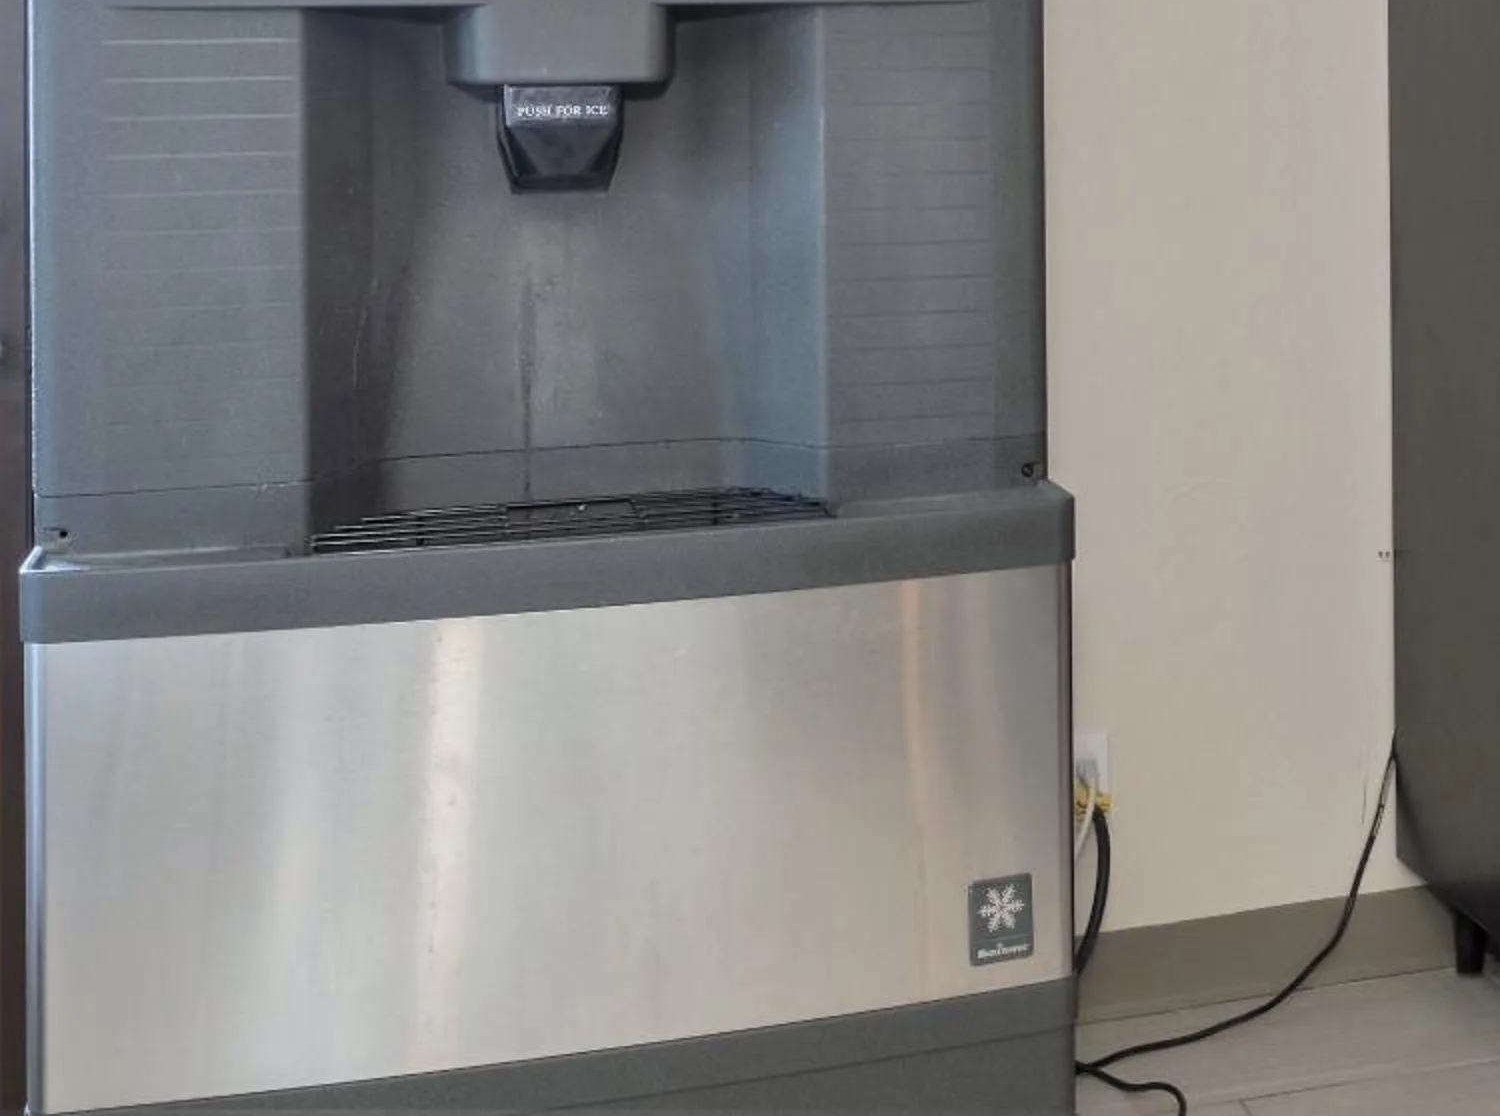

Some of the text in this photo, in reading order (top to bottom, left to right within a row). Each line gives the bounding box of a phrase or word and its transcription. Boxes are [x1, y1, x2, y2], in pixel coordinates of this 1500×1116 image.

[517, 104, 609, 117] PUSH FOR ICE
